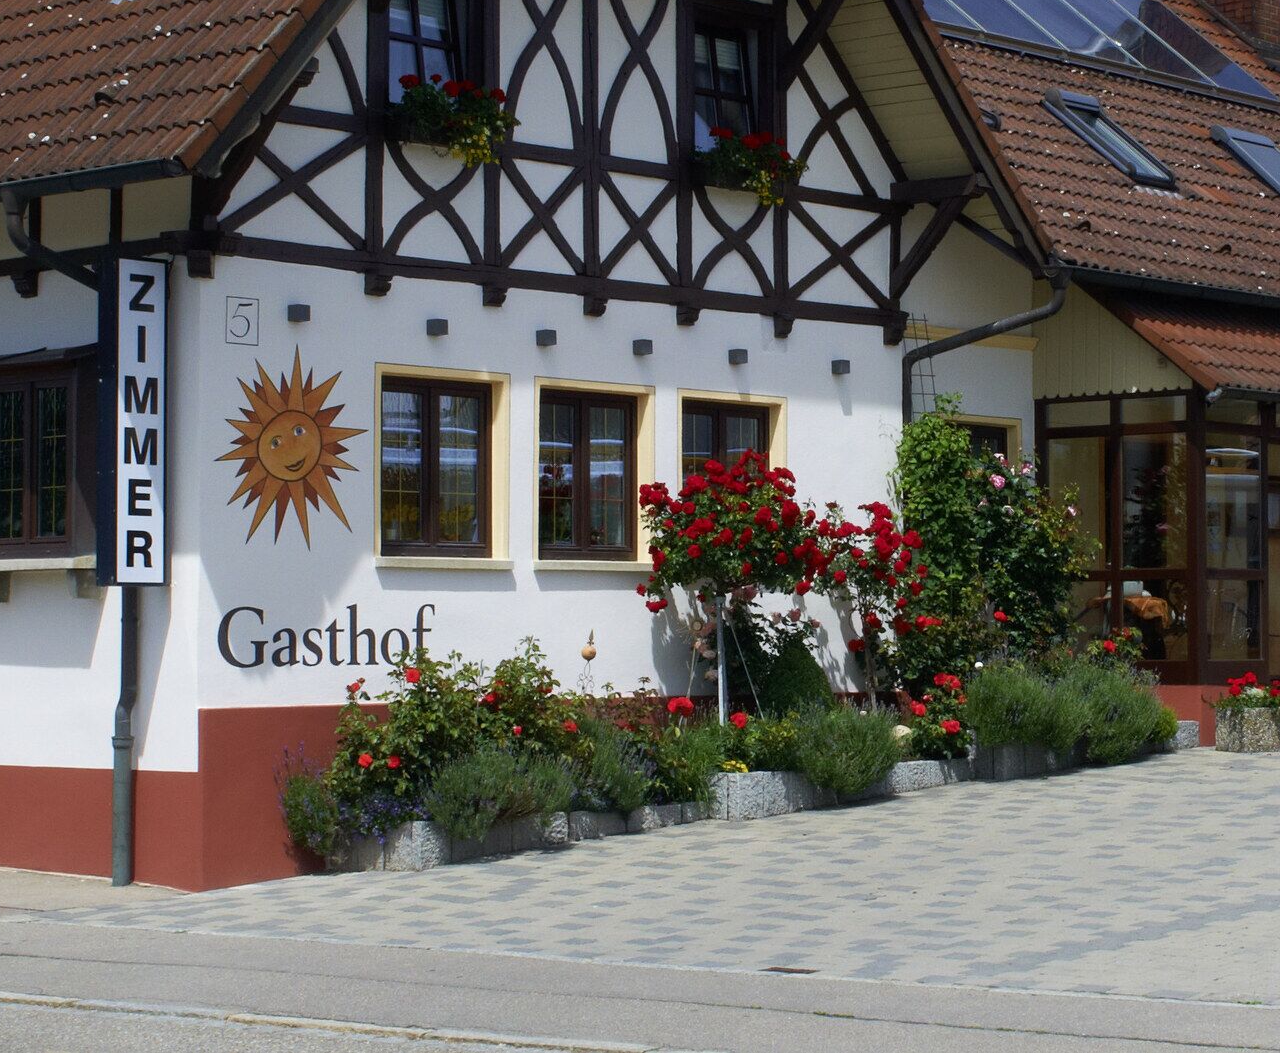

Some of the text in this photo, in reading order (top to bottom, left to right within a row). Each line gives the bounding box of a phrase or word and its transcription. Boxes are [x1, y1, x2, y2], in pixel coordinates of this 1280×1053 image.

[229, 303, 253, 338] 5
[124, 273, 158, 568] ZIMMER
[217, 603, 436, 668] Gasthof
